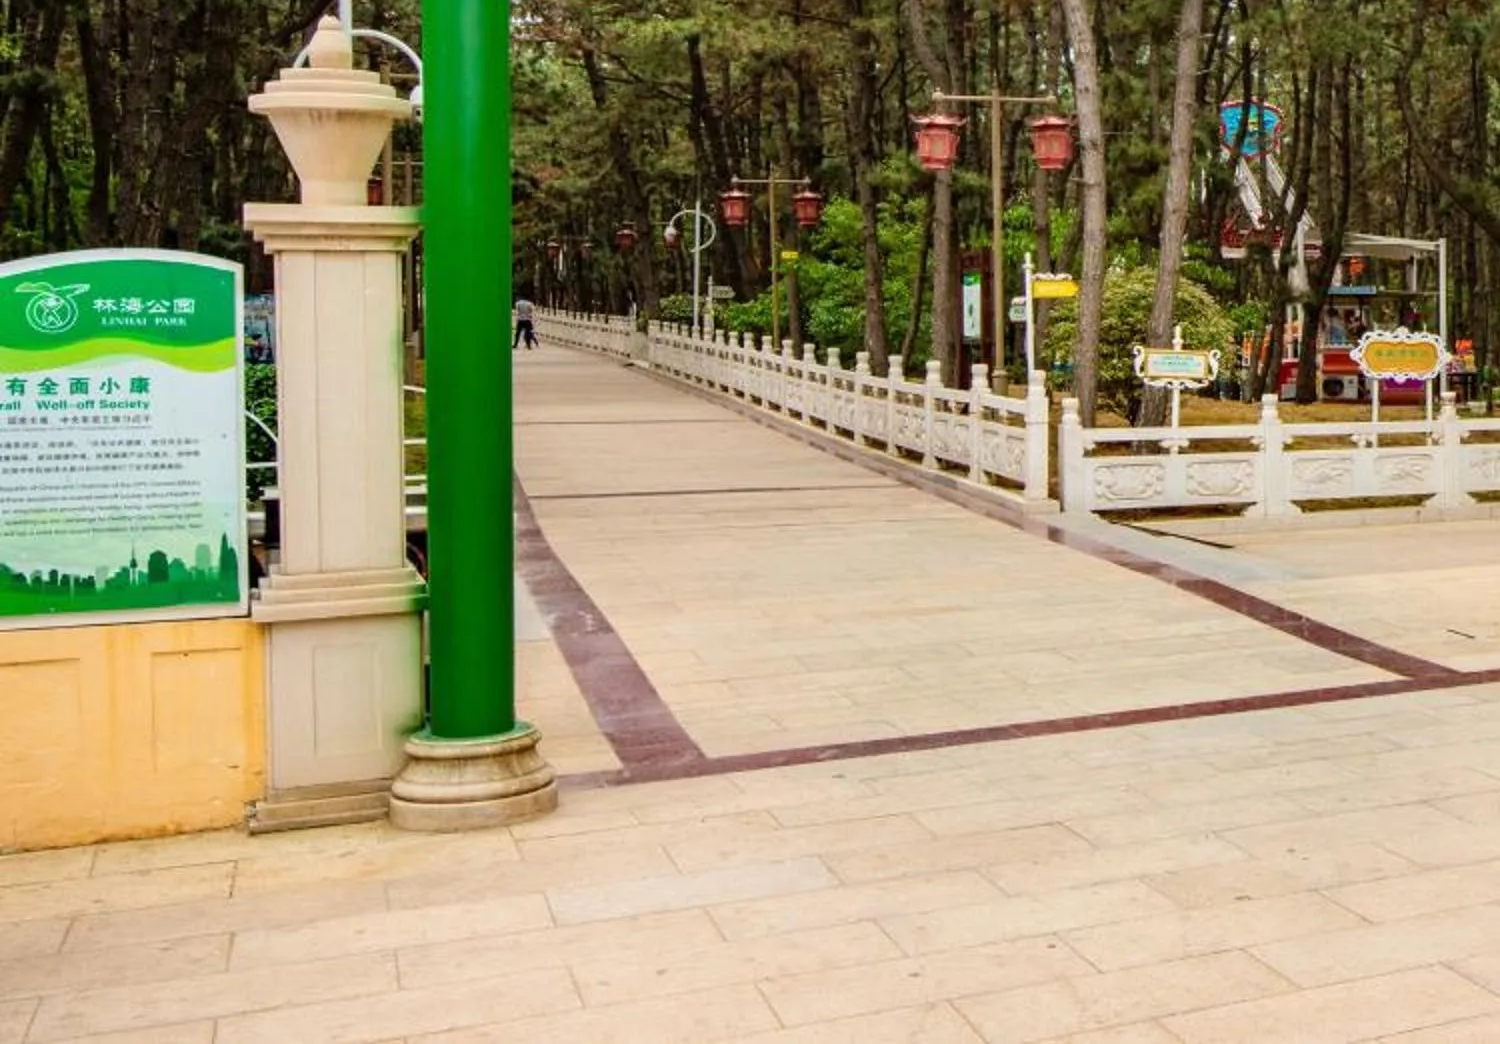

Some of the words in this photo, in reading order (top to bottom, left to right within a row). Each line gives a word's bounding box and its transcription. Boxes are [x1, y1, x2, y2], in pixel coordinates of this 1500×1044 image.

[101, 316, 147, 326] LINHAI
[155, 316, 187, 327] PARK
[6, 376, 151, 396] 有全面小康
[99, 399, 149, 411] Society
